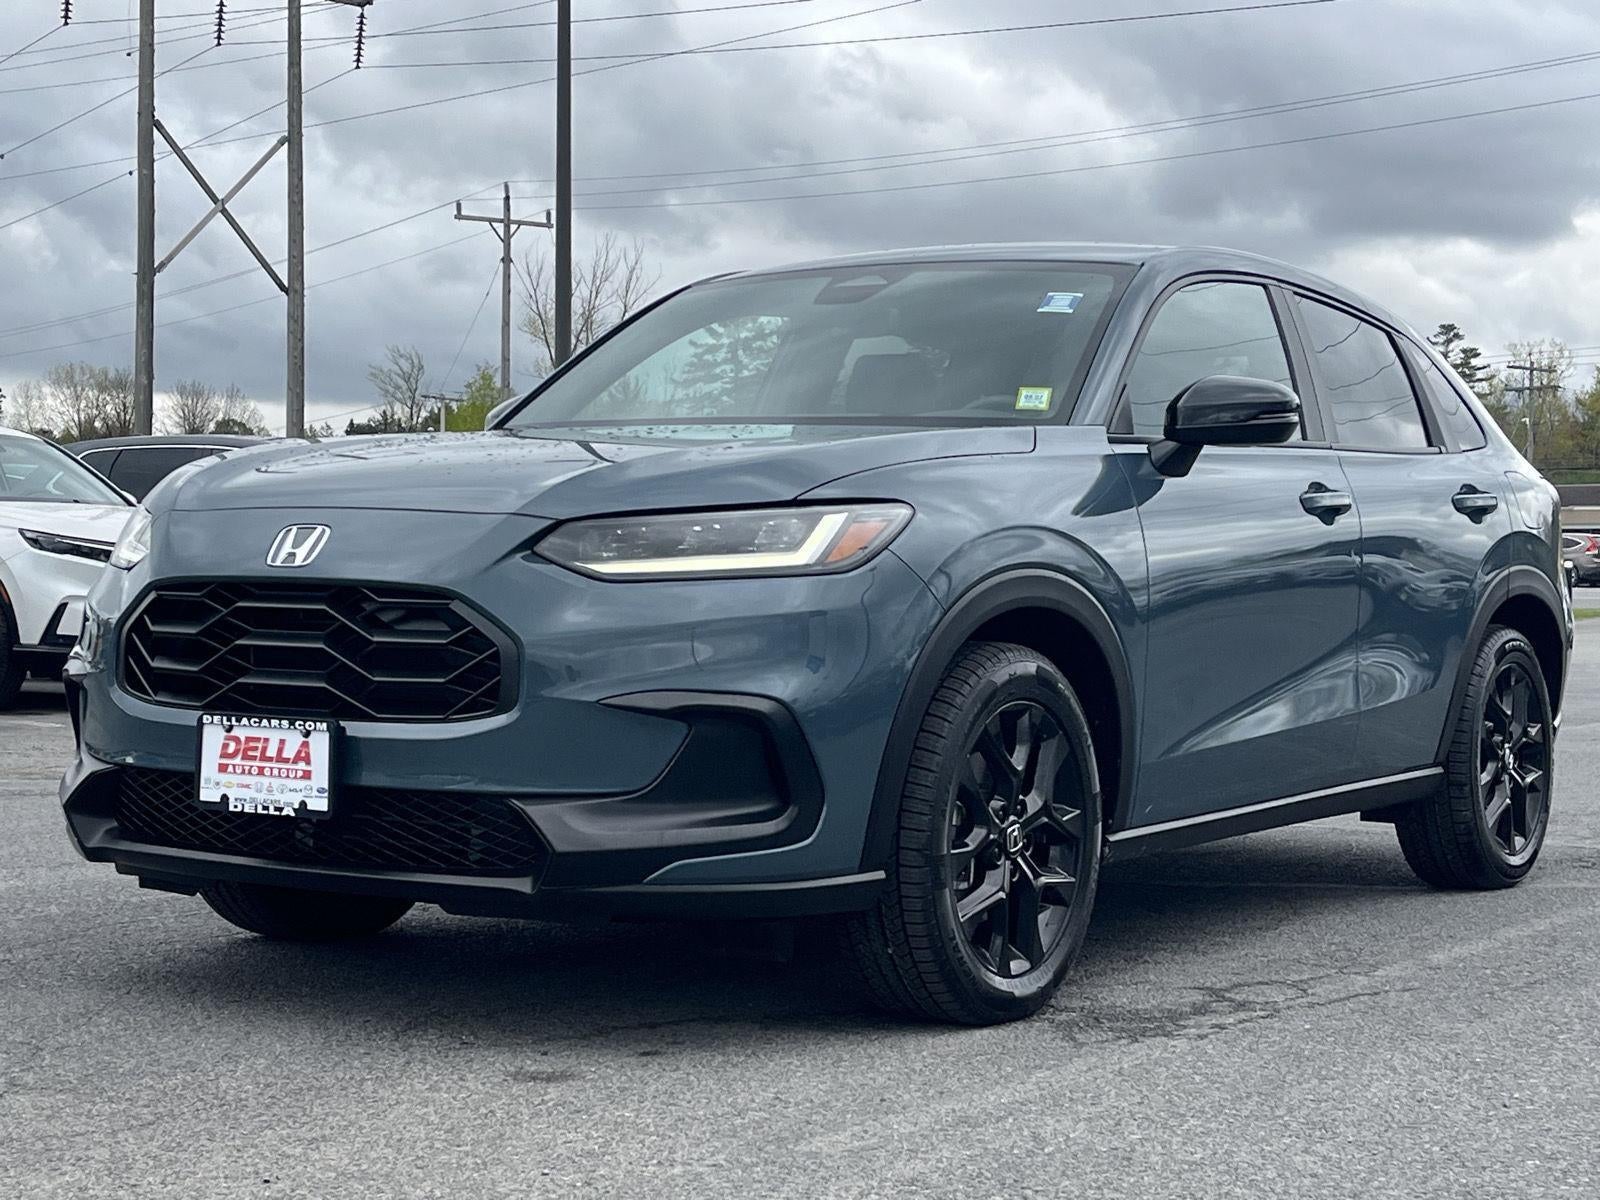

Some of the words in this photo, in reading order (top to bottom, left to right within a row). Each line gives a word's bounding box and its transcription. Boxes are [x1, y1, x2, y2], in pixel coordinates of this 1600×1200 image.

[202, 715, 327, 731] DELLACARS.COM
[219, 734, 312, 766] DELLA
[227, 764, 259, 775] AUTO
[263, 767, 304, 778] GROUP
[228, 803, 296, 816] DELLA
